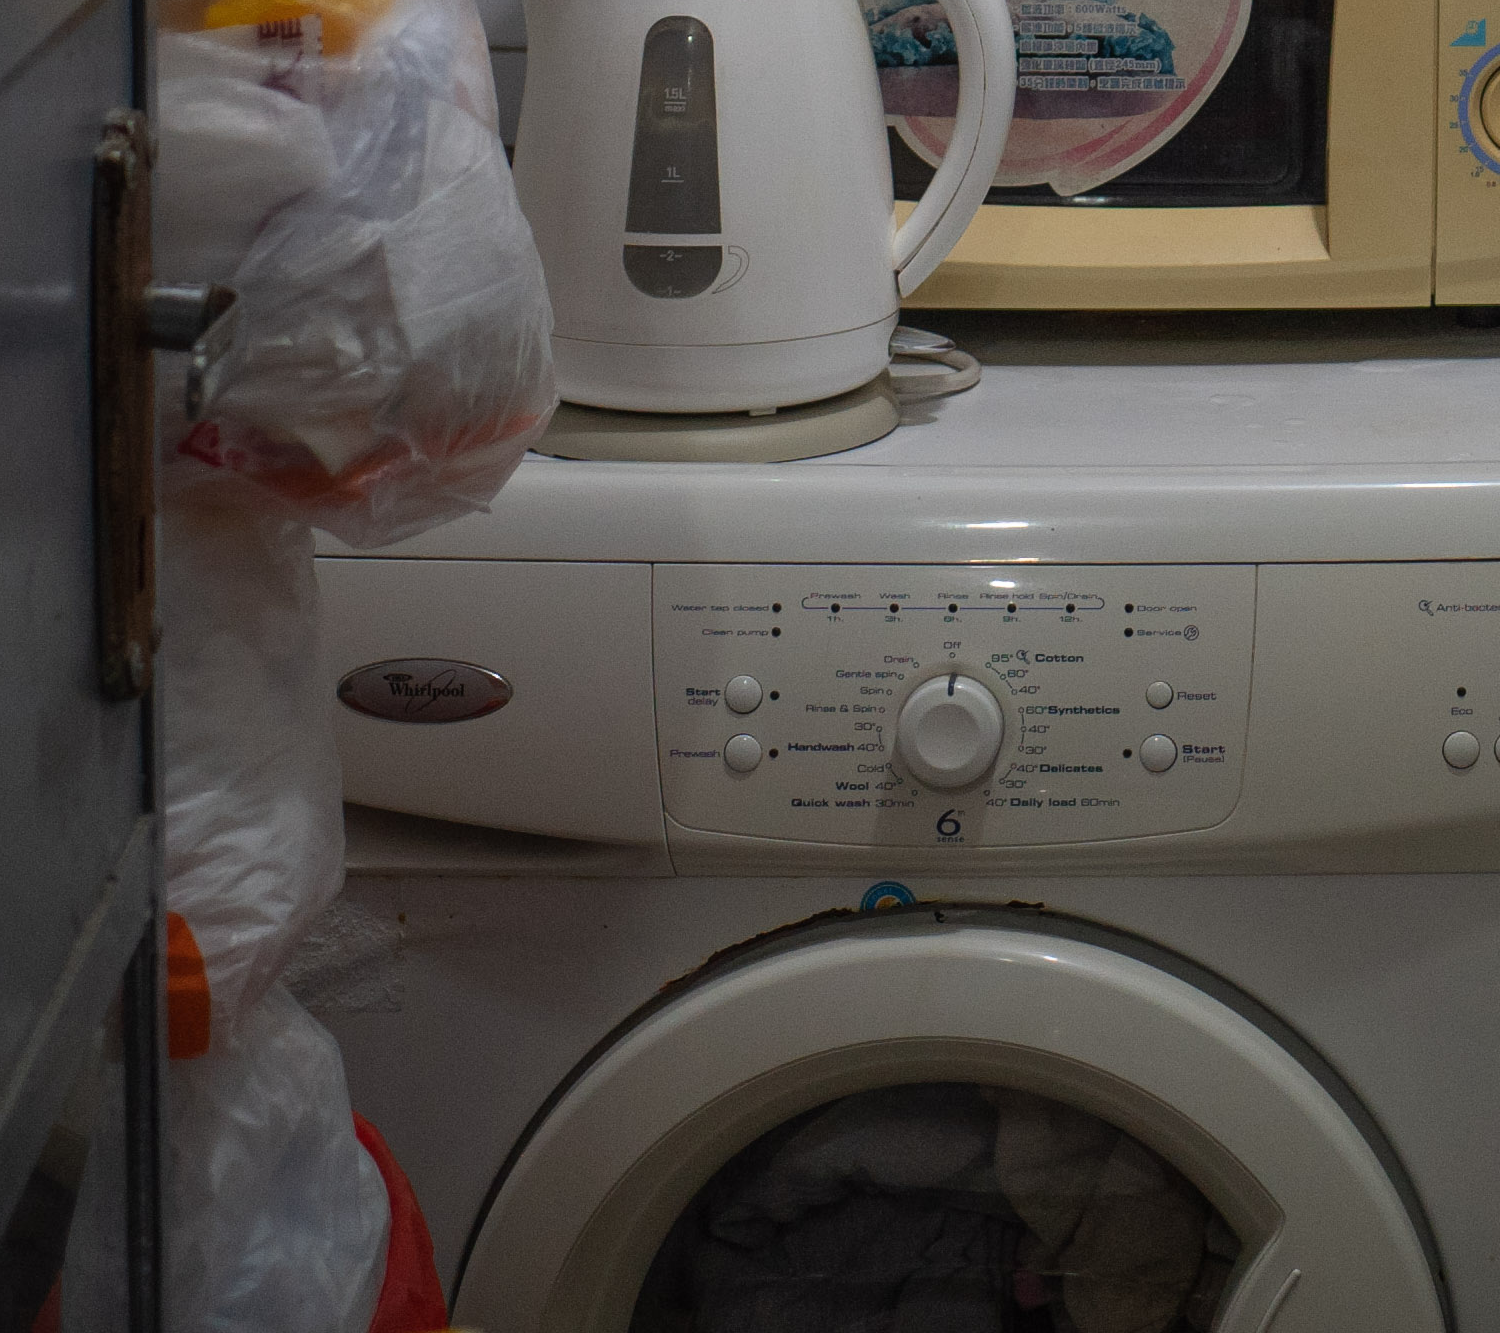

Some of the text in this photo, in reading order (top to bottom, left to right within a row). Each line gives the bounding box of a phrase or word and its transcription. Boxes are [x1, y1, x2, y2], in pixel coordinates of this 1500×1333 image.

[666, 166, 680, 179] 1L
[810, 592, 862, 600] Prewash
[879, 592, 911, 600] Wash
[1011, 592, 1035, 600] hold
[671, 604, 770, 614] Water tap closed
[1137, 604, 1198, 614] Door open
[943, 640, 962, 650] Off
[883, 655, 914, 664] Drain
[1034, 653, 1084, 663] Cotton
[835, 669, 898, 681] Gentle spin
[388, 682, 465, 701] Whirlpool
[685, 687, 721, 697] Start
[859, 686, 885, 696] Spin
[1177, 691, 1217, 701] Reset
[687, 696, 719, 707] delay
[806, 704, 878, 715] Rinse & Spin
[1048, 705, 1121, 716] Synthetics
[1451, 707, 1474, 715] Eco
[787, 742, 855, 753] Handwash
[1182, 744, 1226, 755] Start
[669, 749, 721, 759] Prewash
[857, 764, 885, 774] Cold
[1039, 763, 1104, 774] Delicates
[835, 781, 869, 791] Wool
[791, 798, 915, 808] Quick wash 30min
[1010, 798, 1044, 809] Daily
[1048, 798, 1077, 807] load
